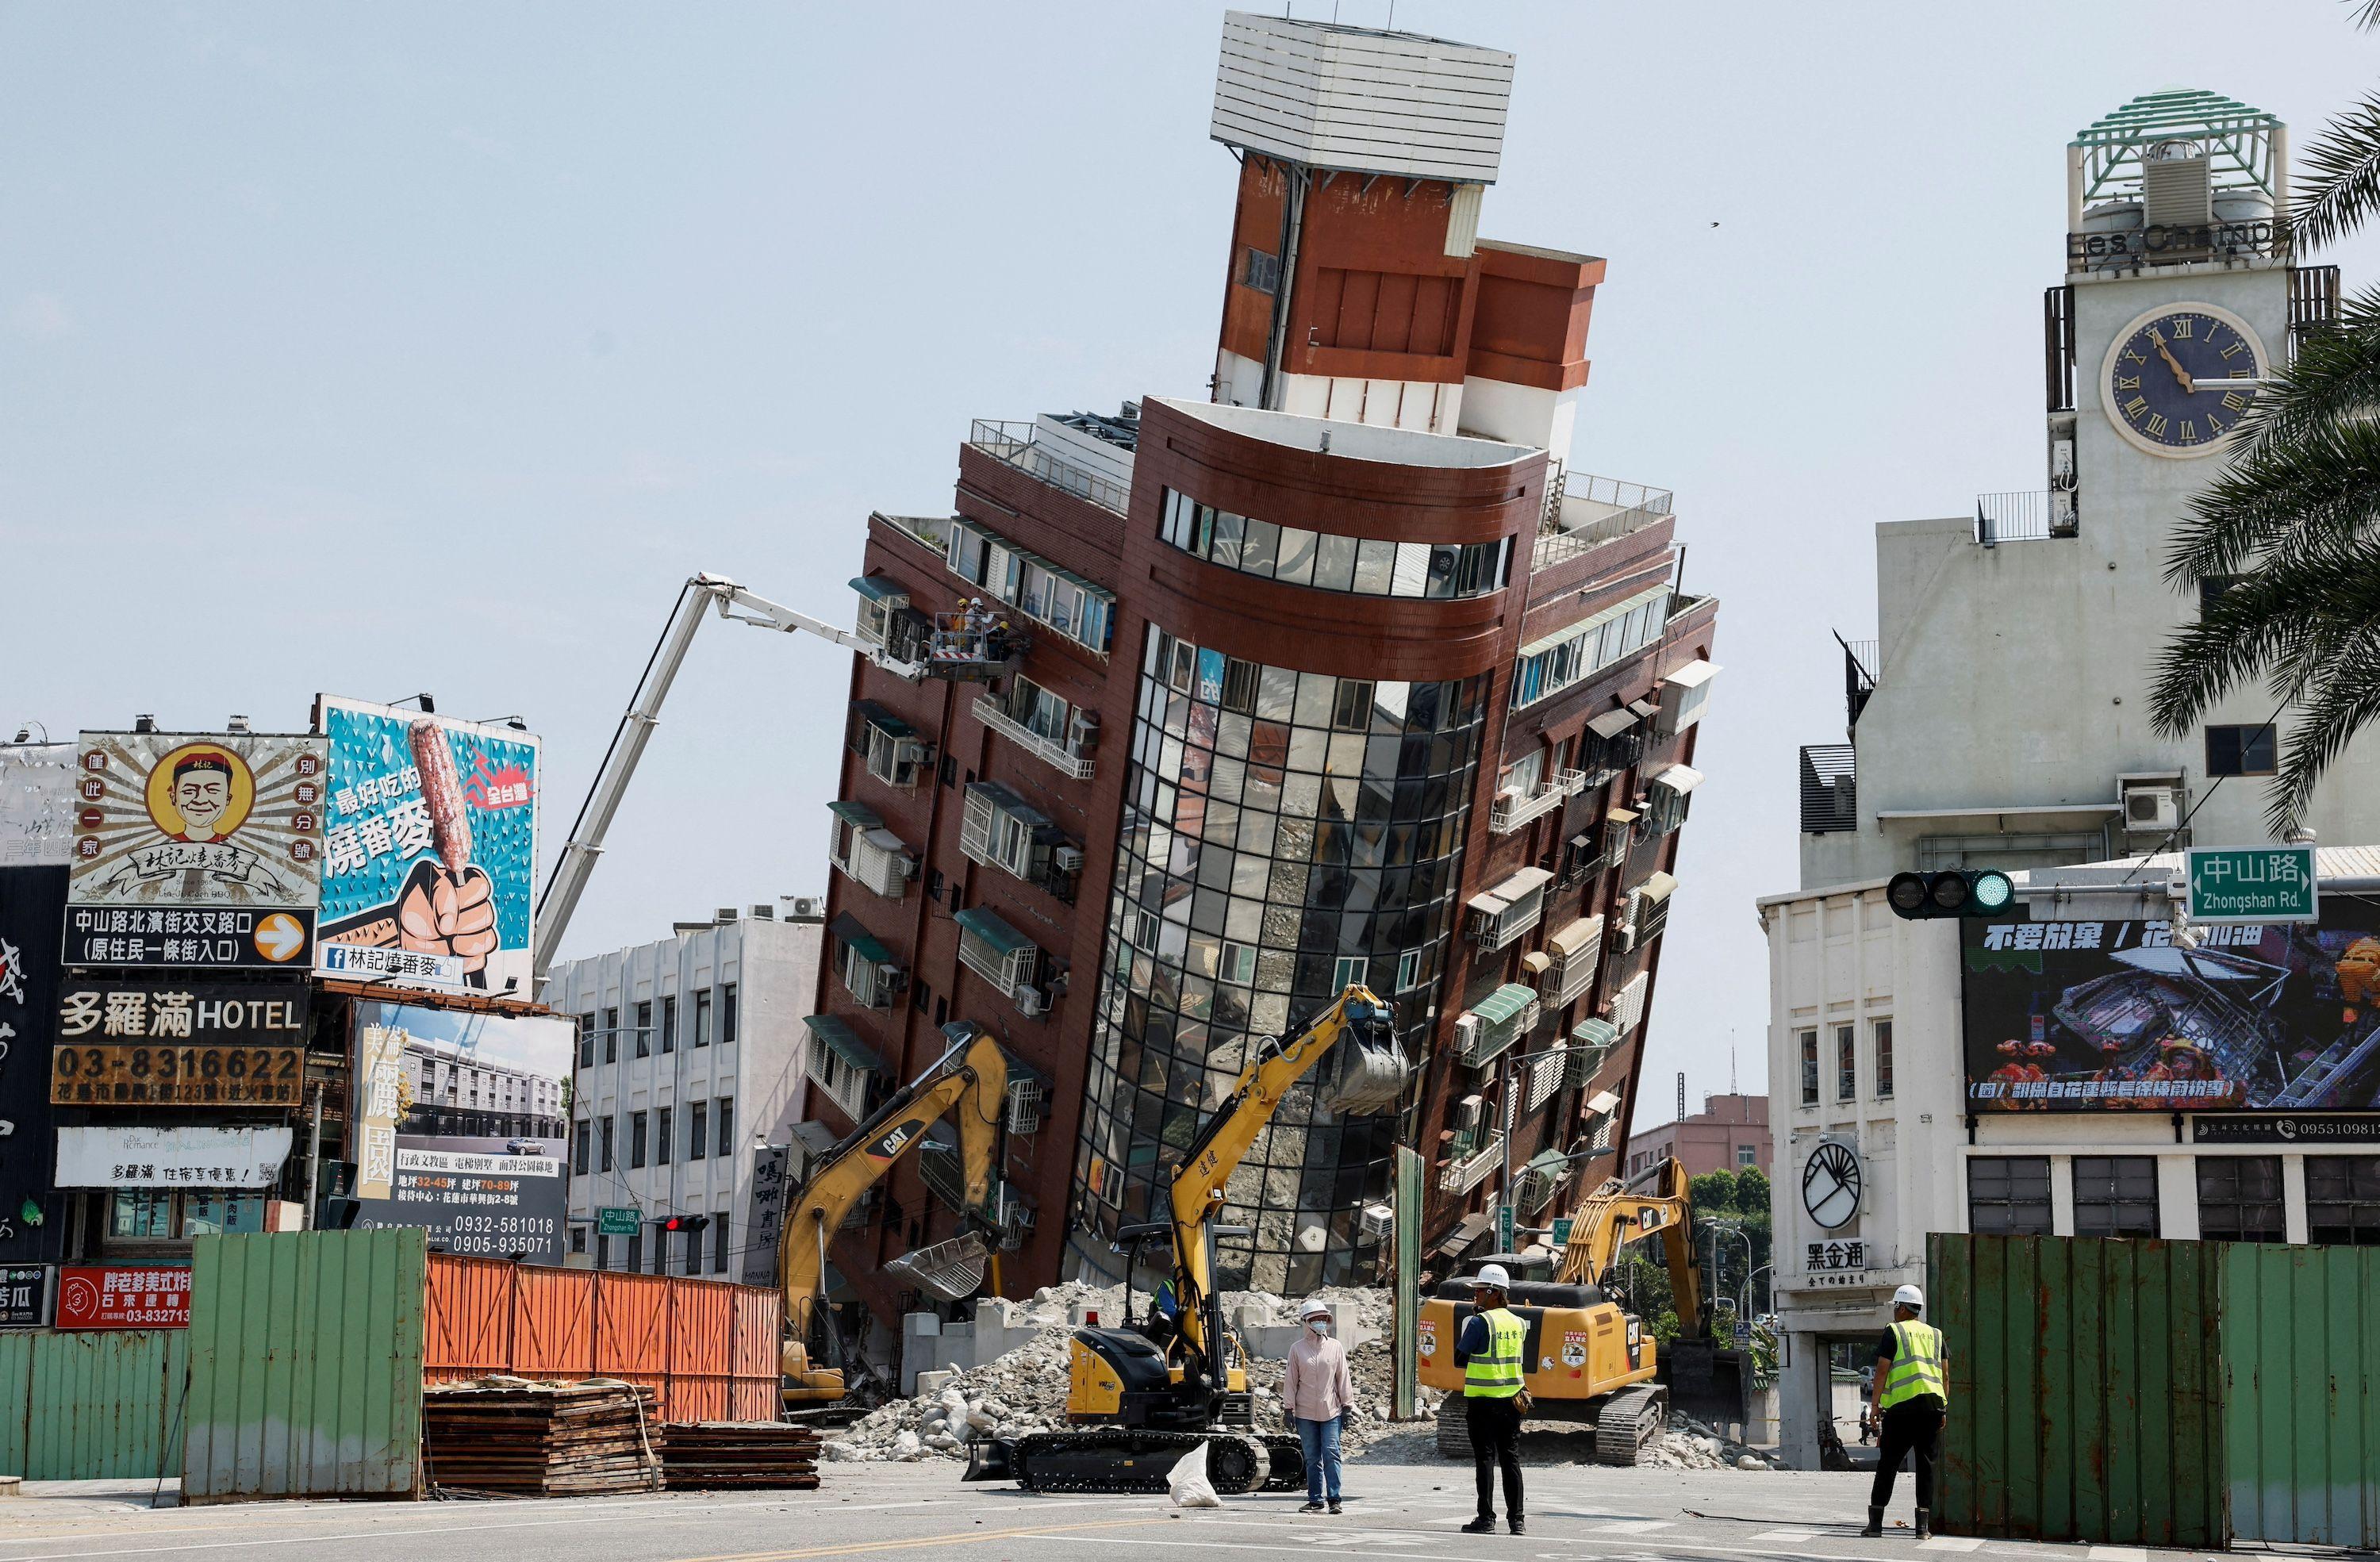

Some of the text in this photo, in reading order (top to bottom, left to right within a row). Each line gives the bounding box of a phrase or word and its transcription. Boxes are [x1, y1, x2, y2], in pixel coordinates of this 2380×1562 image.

[336, 766, 422, 816] 最好吃的
[487, 782, 528, 805] 全台灣
[322, 797, 434, 878] 燒番麥
[2204, 854, 2299, 884] 中山路
[2204, 891, 2301, 913] Zhongshan Rd.
[76, 909, 252, 935] 中山路北濱街交叉路口
[1983, 921, 2105, 951] 不要放棄
[2141, 920, 2264, 949] 花加油
[84, 937, 240, 962] (原住民一條街入口)
[349, 947, 437, 977] 林記燒番麥
[60, 991, 302, 1038] 多羅滿 HOTEL
[58, 1048, 298, 1080] 03-8316622
[882, 1126, 909, 1155] CAT
[110, 1164, 156, 1181] 多羅滿
[400, 1153, 554, 1173] 行政文教區 電梯別墅 面對公園綠地
[397, 1175, 520, 1192] 地坪32-45坪 建坪70-89坪
[455, 1215, 554, 1234] 0932-581018
[605, 1210, 635, 1222] 中山路
[453, 1235, 552, 1254] 0905-935071
[1807, 1242, 1864, 1270] 黑金通
[103, 1272, 191, 1293] 胖老爹美式炸
[1809, 1274, 1864, 1287] 全ての始まり
[1628, 1322, 1639, 1345] CAT
